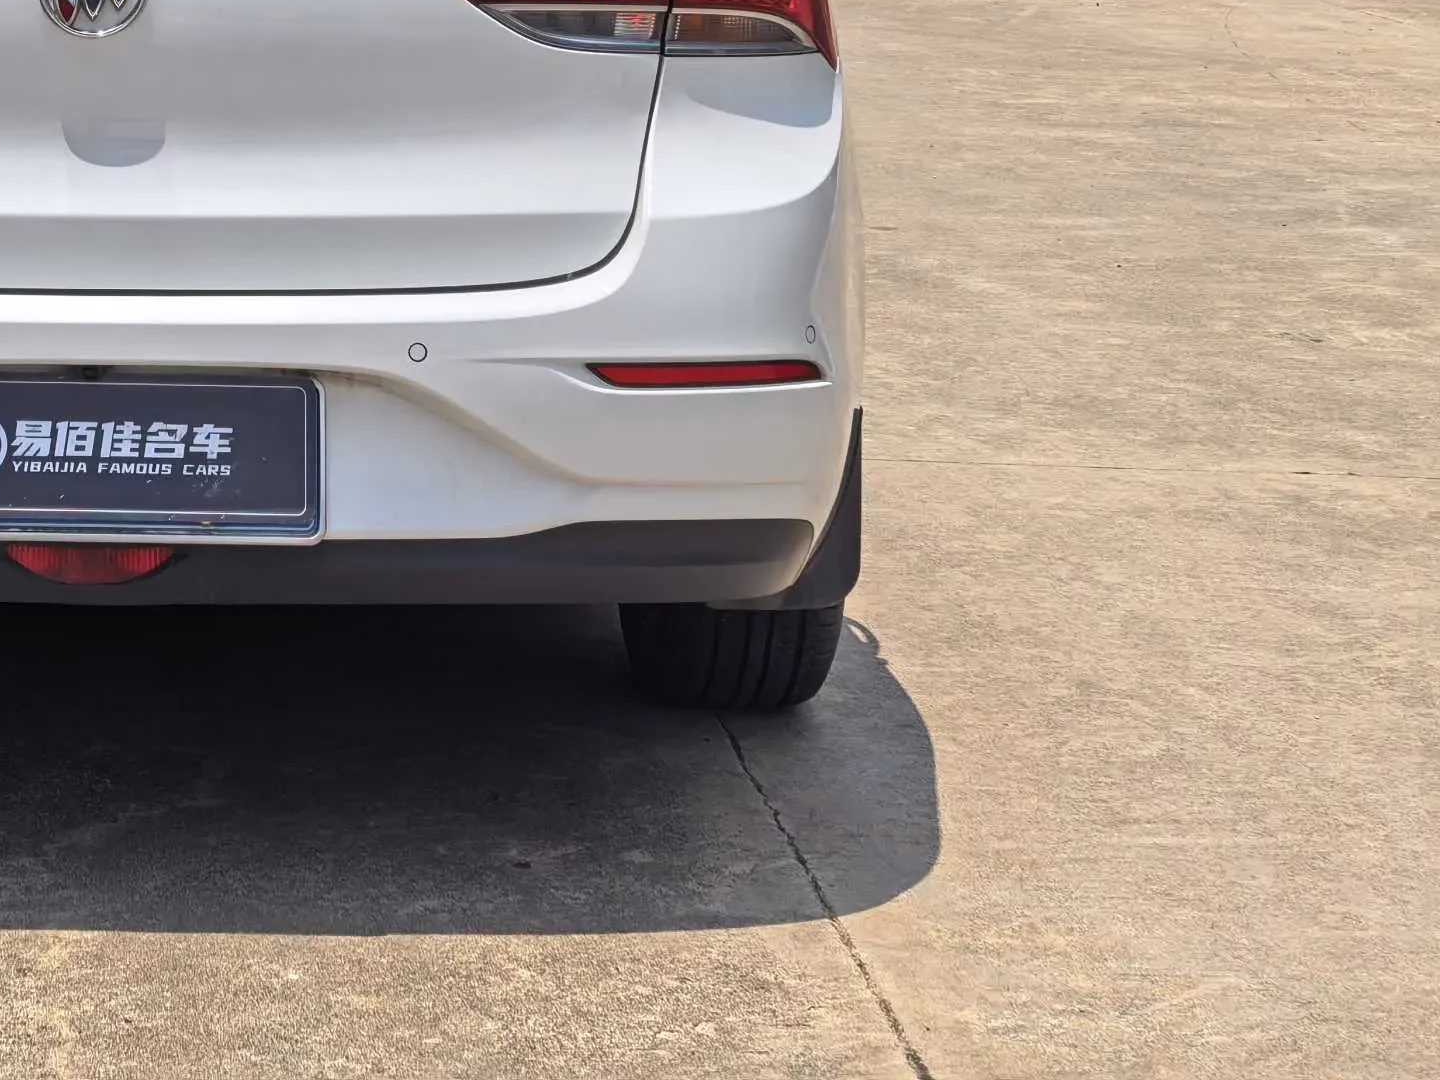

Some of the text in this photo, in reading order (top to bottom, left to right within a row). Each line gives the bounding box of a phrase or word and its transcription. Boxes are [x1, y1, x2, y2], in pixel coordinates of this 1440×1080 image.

[10, 420, 234, 460] 易佰佳名车
[11, 460, 232, 477] YIBAIJIA FAMOUS CARS
